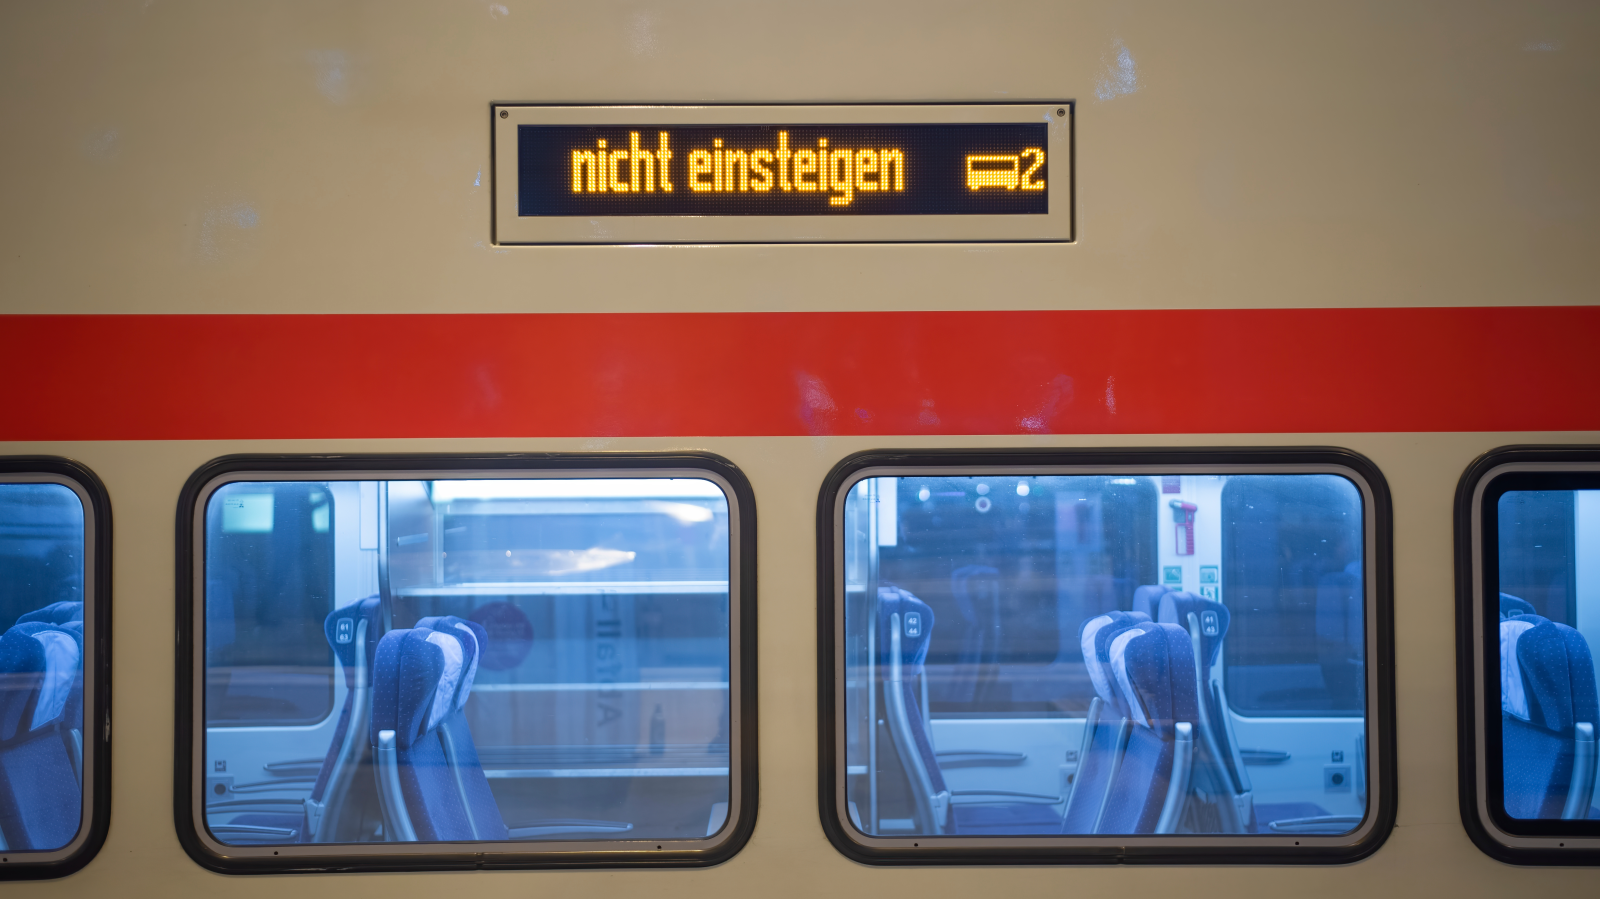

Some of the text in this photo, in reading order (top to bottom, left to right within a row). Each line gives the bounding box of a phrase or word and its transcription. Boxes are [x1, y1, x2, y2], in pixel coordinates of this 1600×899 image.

[571, 130, 905, 207] nicht einsteigen
[1020, 147, 1047, 192] 2
[1204, 616, 1214, 624] 41
[340, 623, 349, 631] 61
[339, 633, 349, 641] 63
